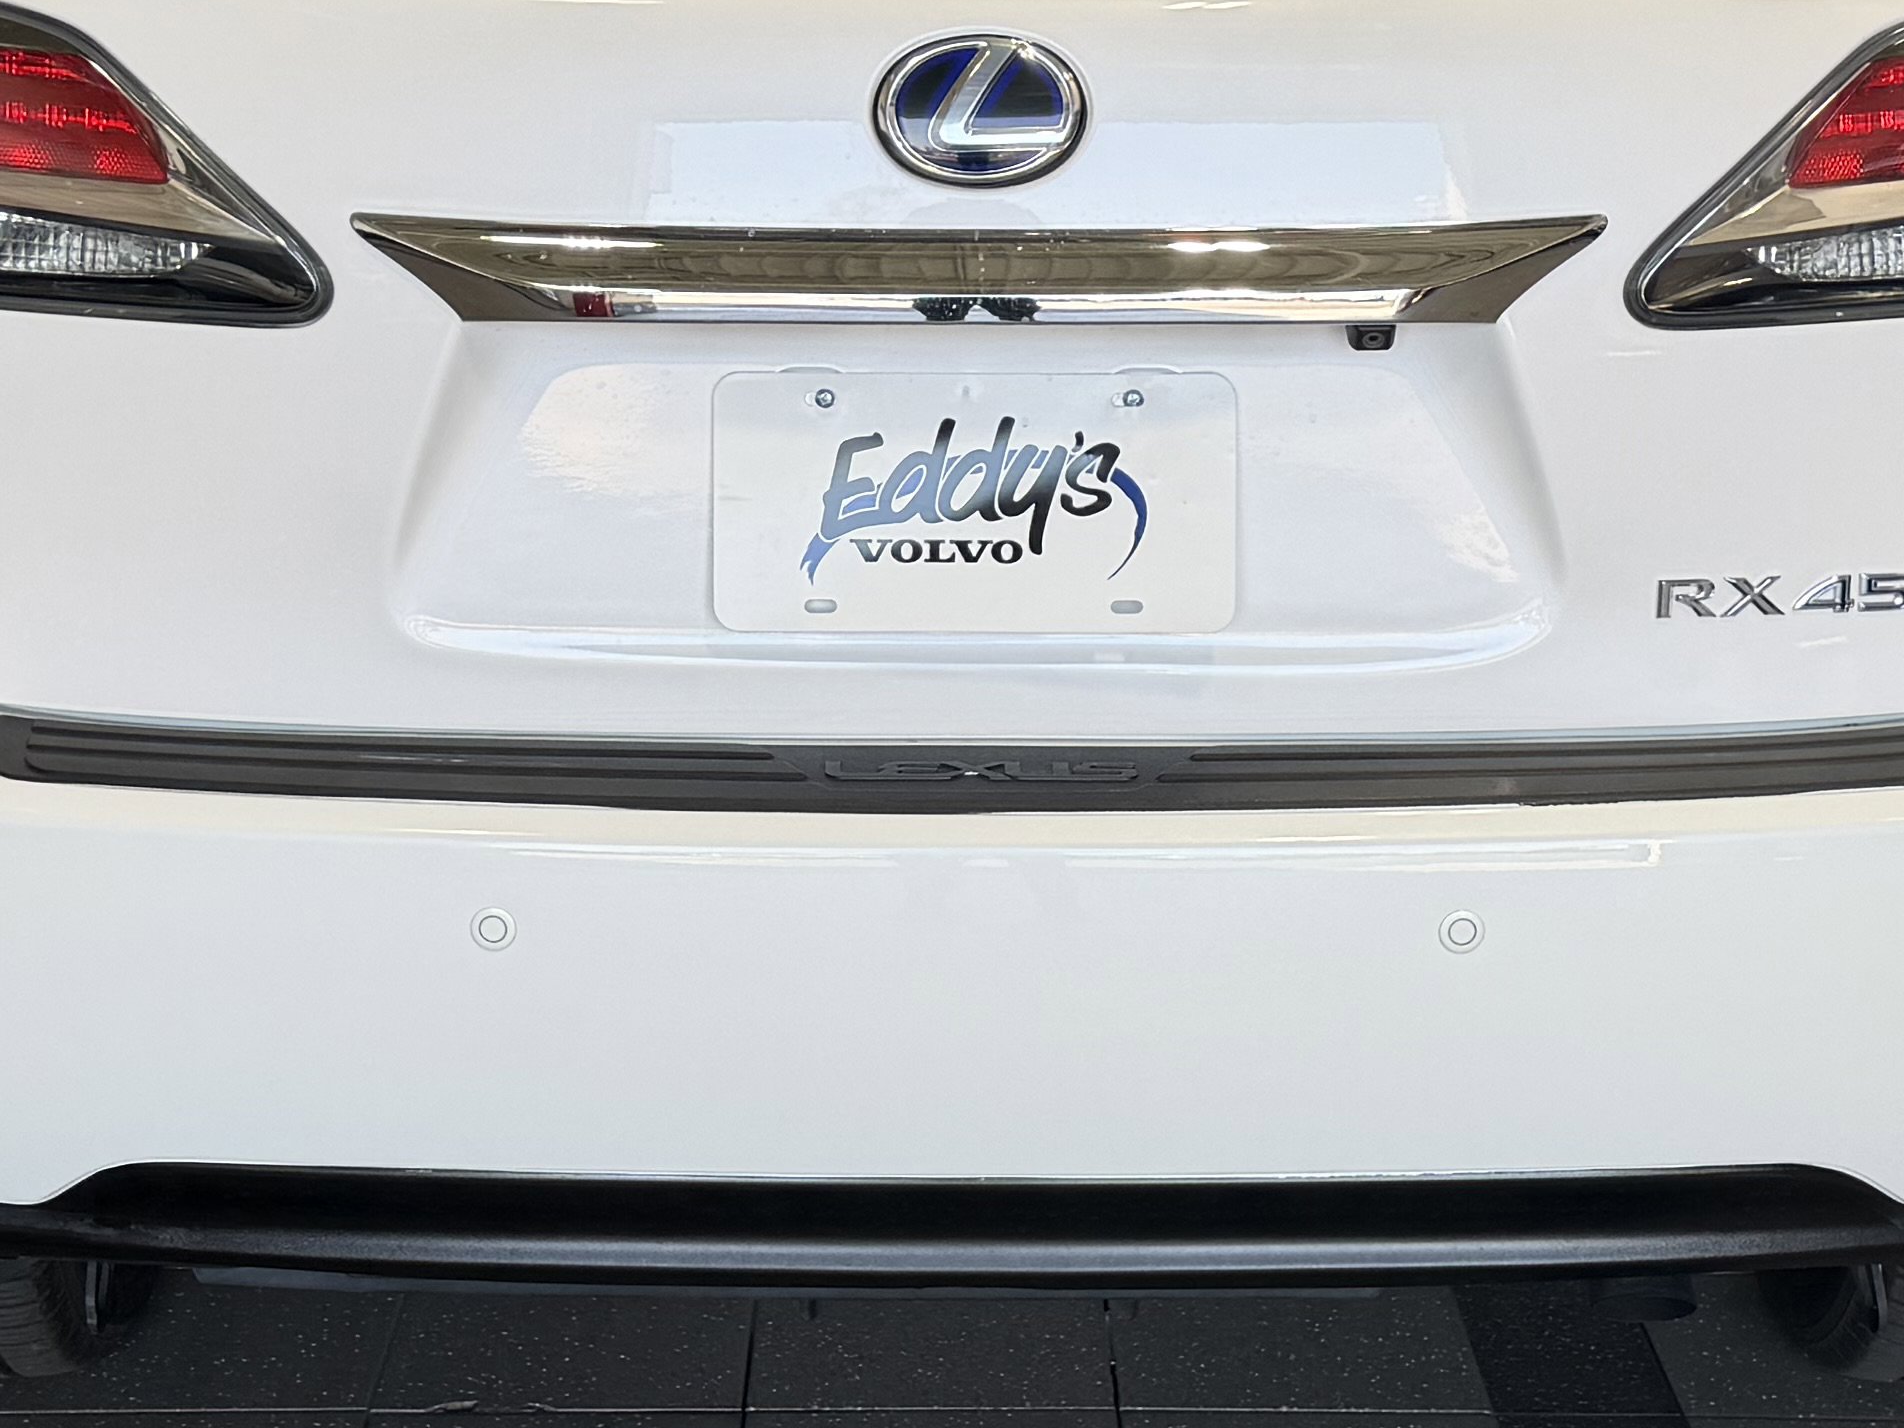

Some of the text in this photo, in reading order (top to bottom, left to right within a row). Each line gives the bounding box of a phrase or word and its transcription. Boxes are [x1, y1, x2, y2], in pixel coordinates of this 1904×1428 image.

[818, 415, 1122, 556] Eddy's
[849, 537, 1024, 565] VOLVO
[1654, 574, 1786, 619] RX
[824, 759, 1140, 782] LEXUS
